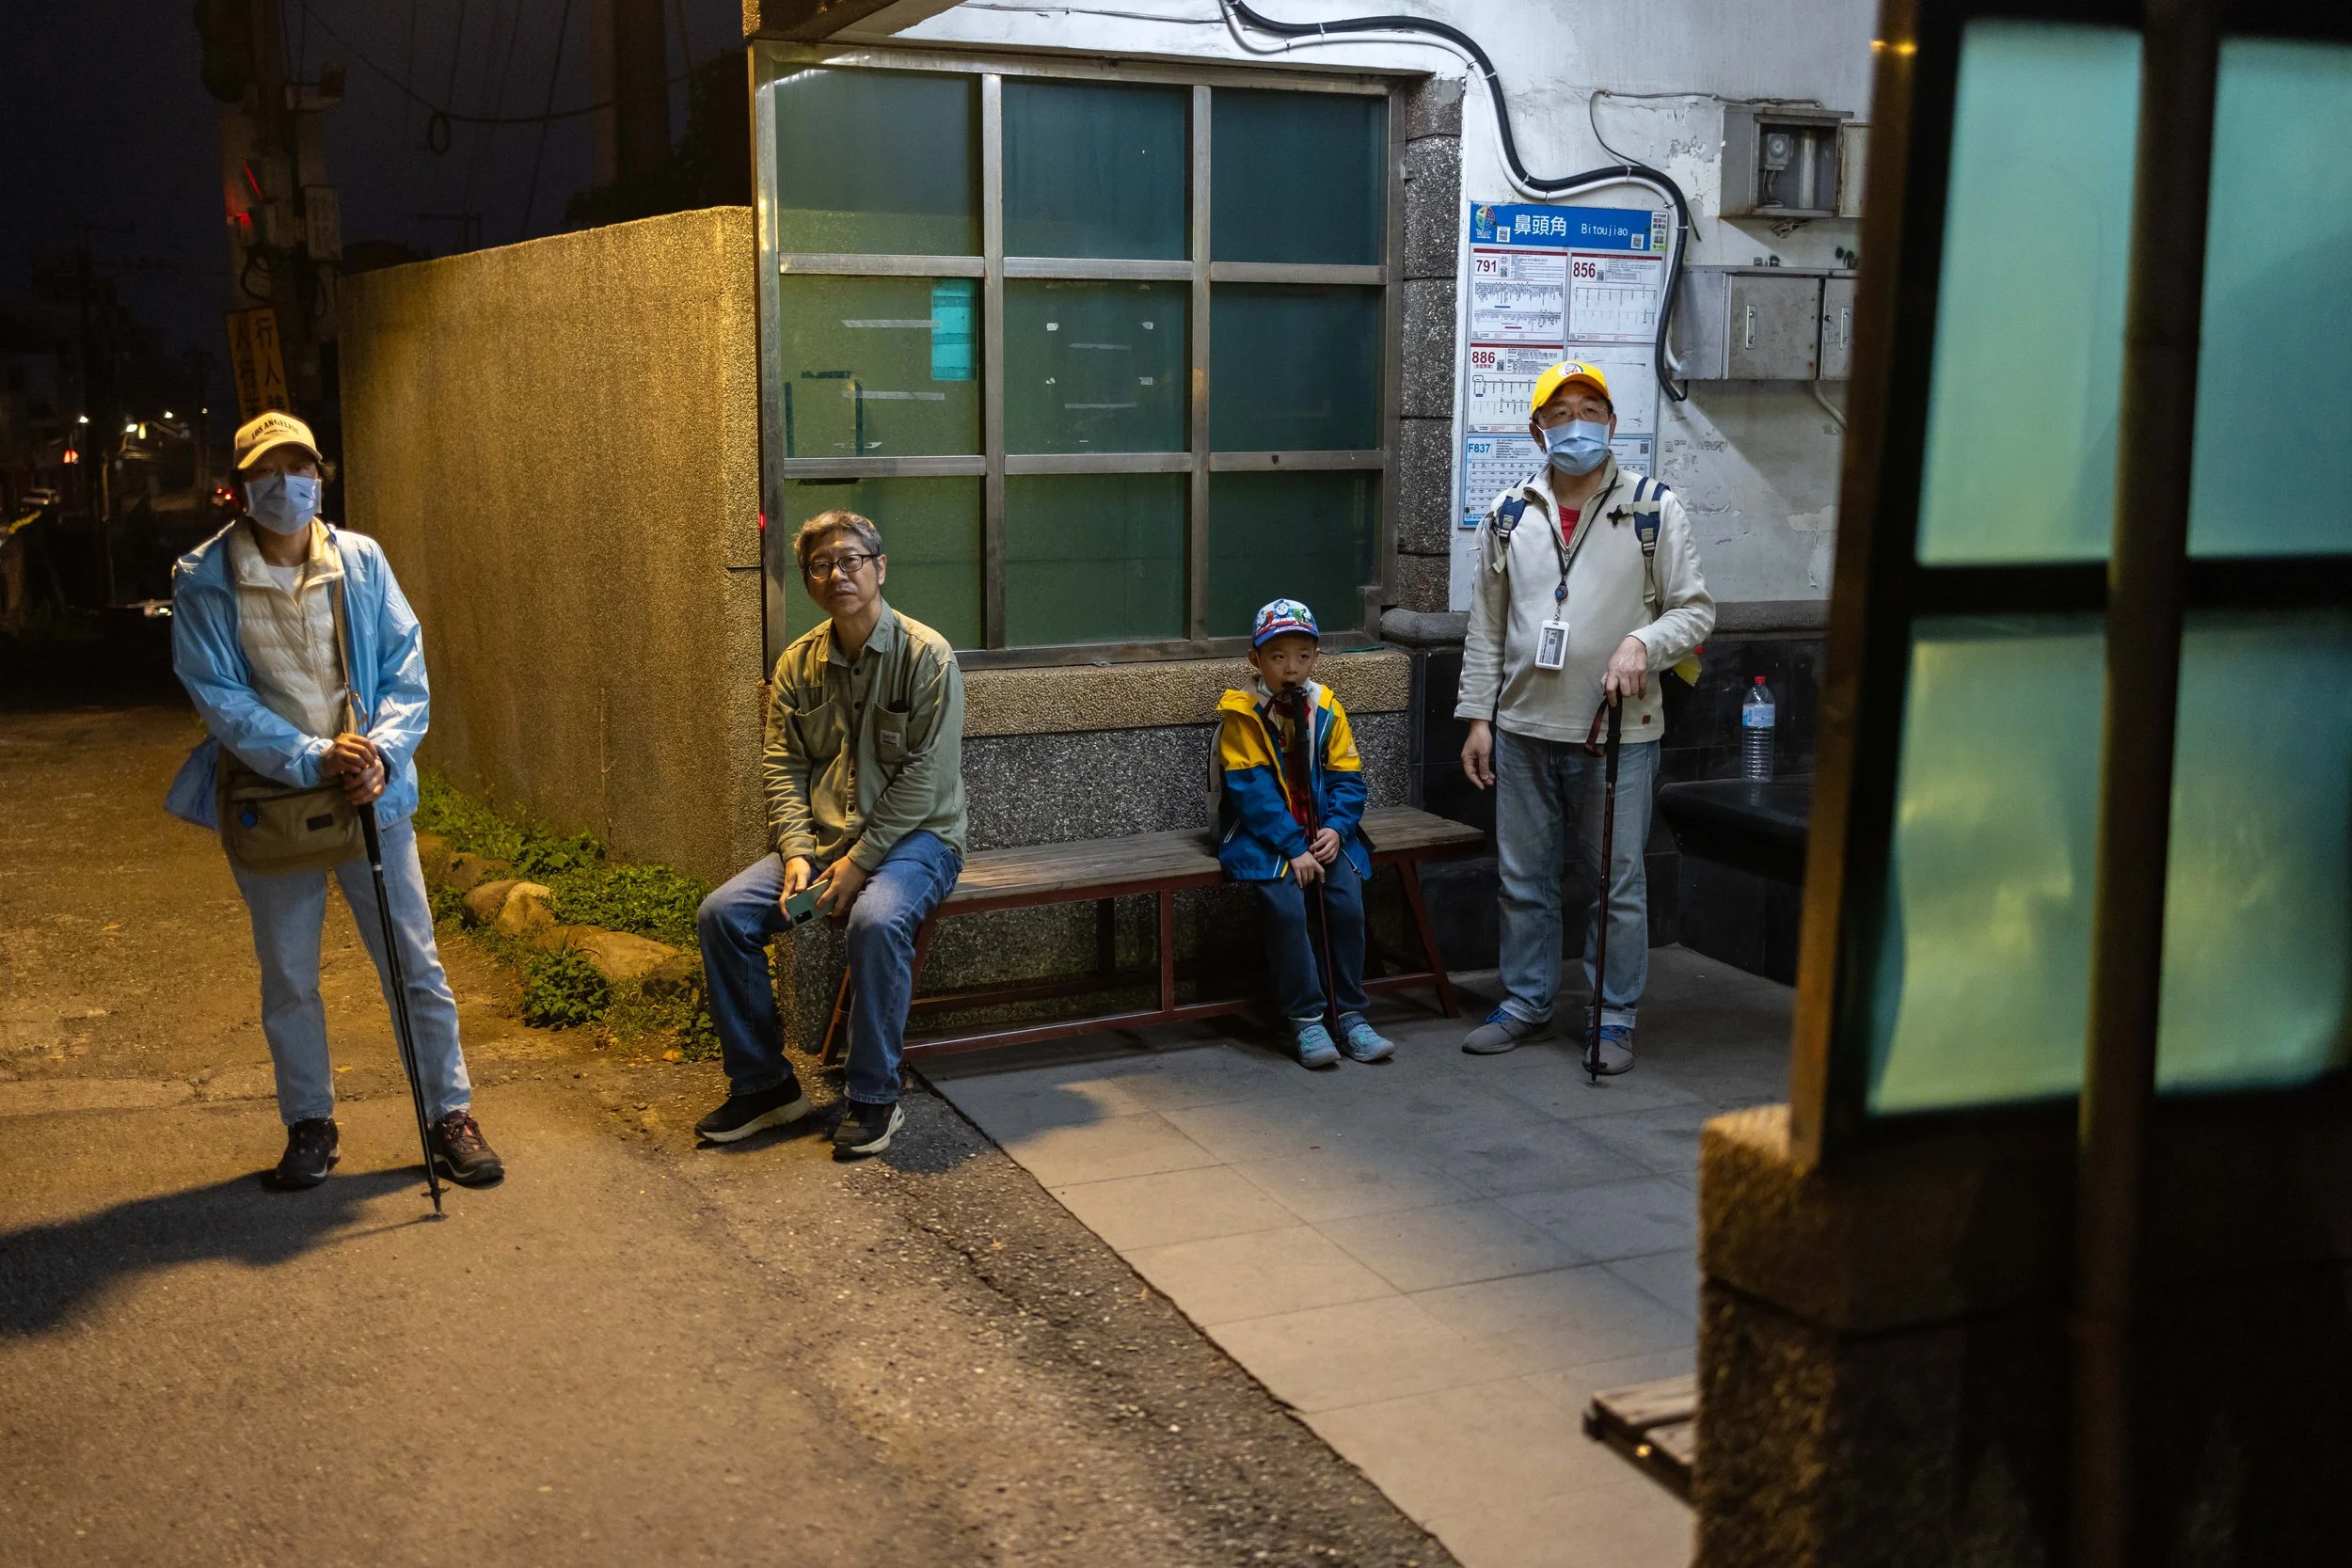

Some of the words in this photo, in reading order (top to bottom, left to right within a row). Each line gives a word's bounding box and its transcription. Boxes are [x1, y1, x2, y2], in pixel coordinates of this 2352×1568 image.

[1514, 214, 1566, 237] 鼻頭角
[1581, 223, 1629, 237] Bitoujiao
[1476, 260, 1497, 273] 791
[1573, 261, 1596, 277] 856
[1471, 351, 1496, 364] 886
[251, 425, 263, 440] LOS
[1468, 443, 1491, 453] F837
